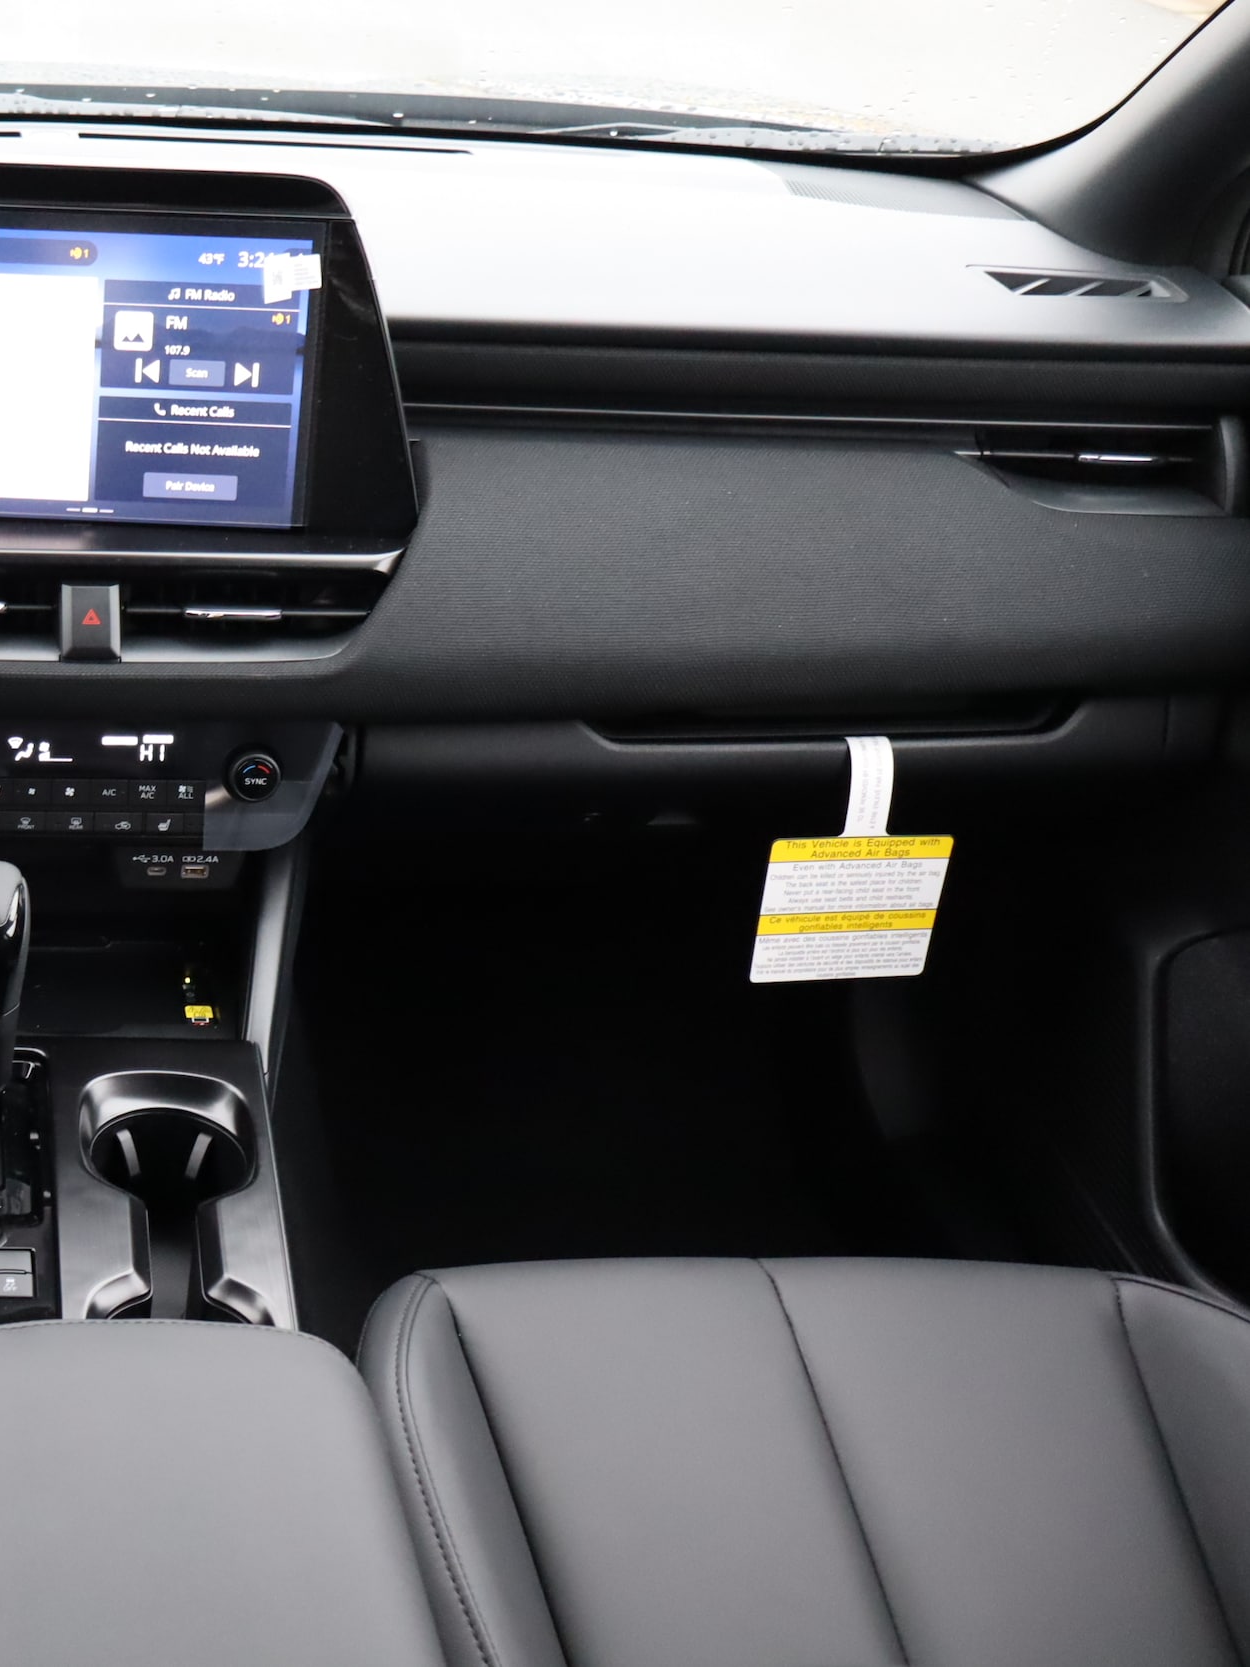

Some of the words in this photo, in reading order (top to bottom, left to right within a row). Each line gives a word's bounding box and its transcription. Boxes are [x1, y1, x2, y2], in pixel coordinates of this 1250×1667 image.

[184, 288, 202, 300] FM
[204, 289, 236, 301] Radio
[165, 315, 188, 330] FM
[164, 345, 191, 356] 107.9
[185, 368, 209, 378] Scan
[170, 404, 208, 417] Recent
[209, 405, 235, 418] Calls
[125, 440, 162, 453] Recent
[163, 442, 189, 455] Calls
[190, 443, 211, 455] Not
[212, 444, 260, 457] Available
[165, 480, 184, 491] Pair
[185, 481, 215, 492] Device
[244, 777, 267, 786] SYNC
[102, 788, 116, 796] A/C
[786, 841, 807, 849] This
[812, 840, 848, 848] Vehicle
[867, 838, 915, 848] Equipped
[920, 838, 940, 846] with
[811, 850, 861, 858] Advanced
[865, 849, 880, 857] Air
[885, 849, 910, 858] Bags
[152, 855, 174, 863] 3.0A
[196, 855, 219, 863] 2.4A
[839, 861, 882, 870] Advanced
[901, 861, 922, 869] Bags
[769, 916, 781, 924] Ce
[786, 915, 821, 923] véhicule
[875, 912, 885, 920] de
[847, 921, 892, 931] intelligents
